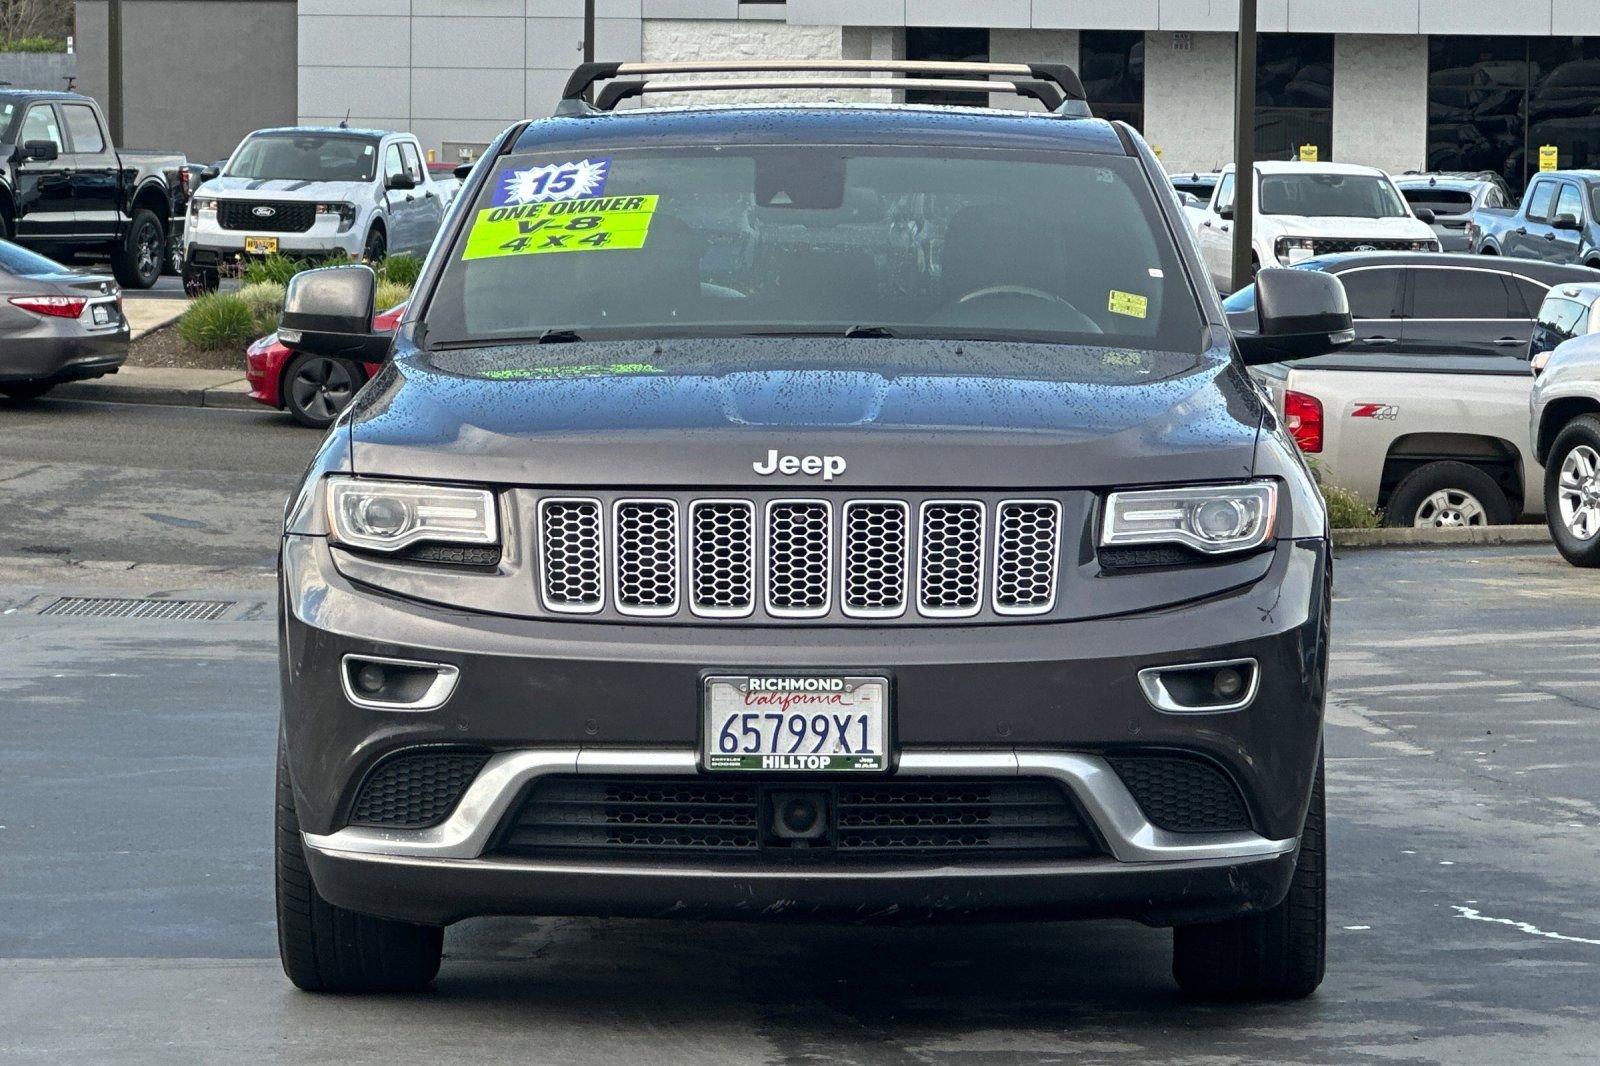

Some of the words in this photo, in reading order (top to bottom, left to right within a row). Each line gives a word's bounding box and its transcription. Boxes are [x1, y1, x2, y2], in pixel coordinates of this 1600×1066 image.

[531, 168, 579, 195] 15
[487, 204, 544, 223] ONE
[549, 196, 645, 216] OWNER
[518, 215, 603, 234] V-8
[752, 449, 847, 480] Jeep
[749, 678, 843, 691] RICHMOND
[744, 690, 854, 712] California
[718, 713, 875, 754] 65799X1
[762, 755, 831, 769] HILLTOP
